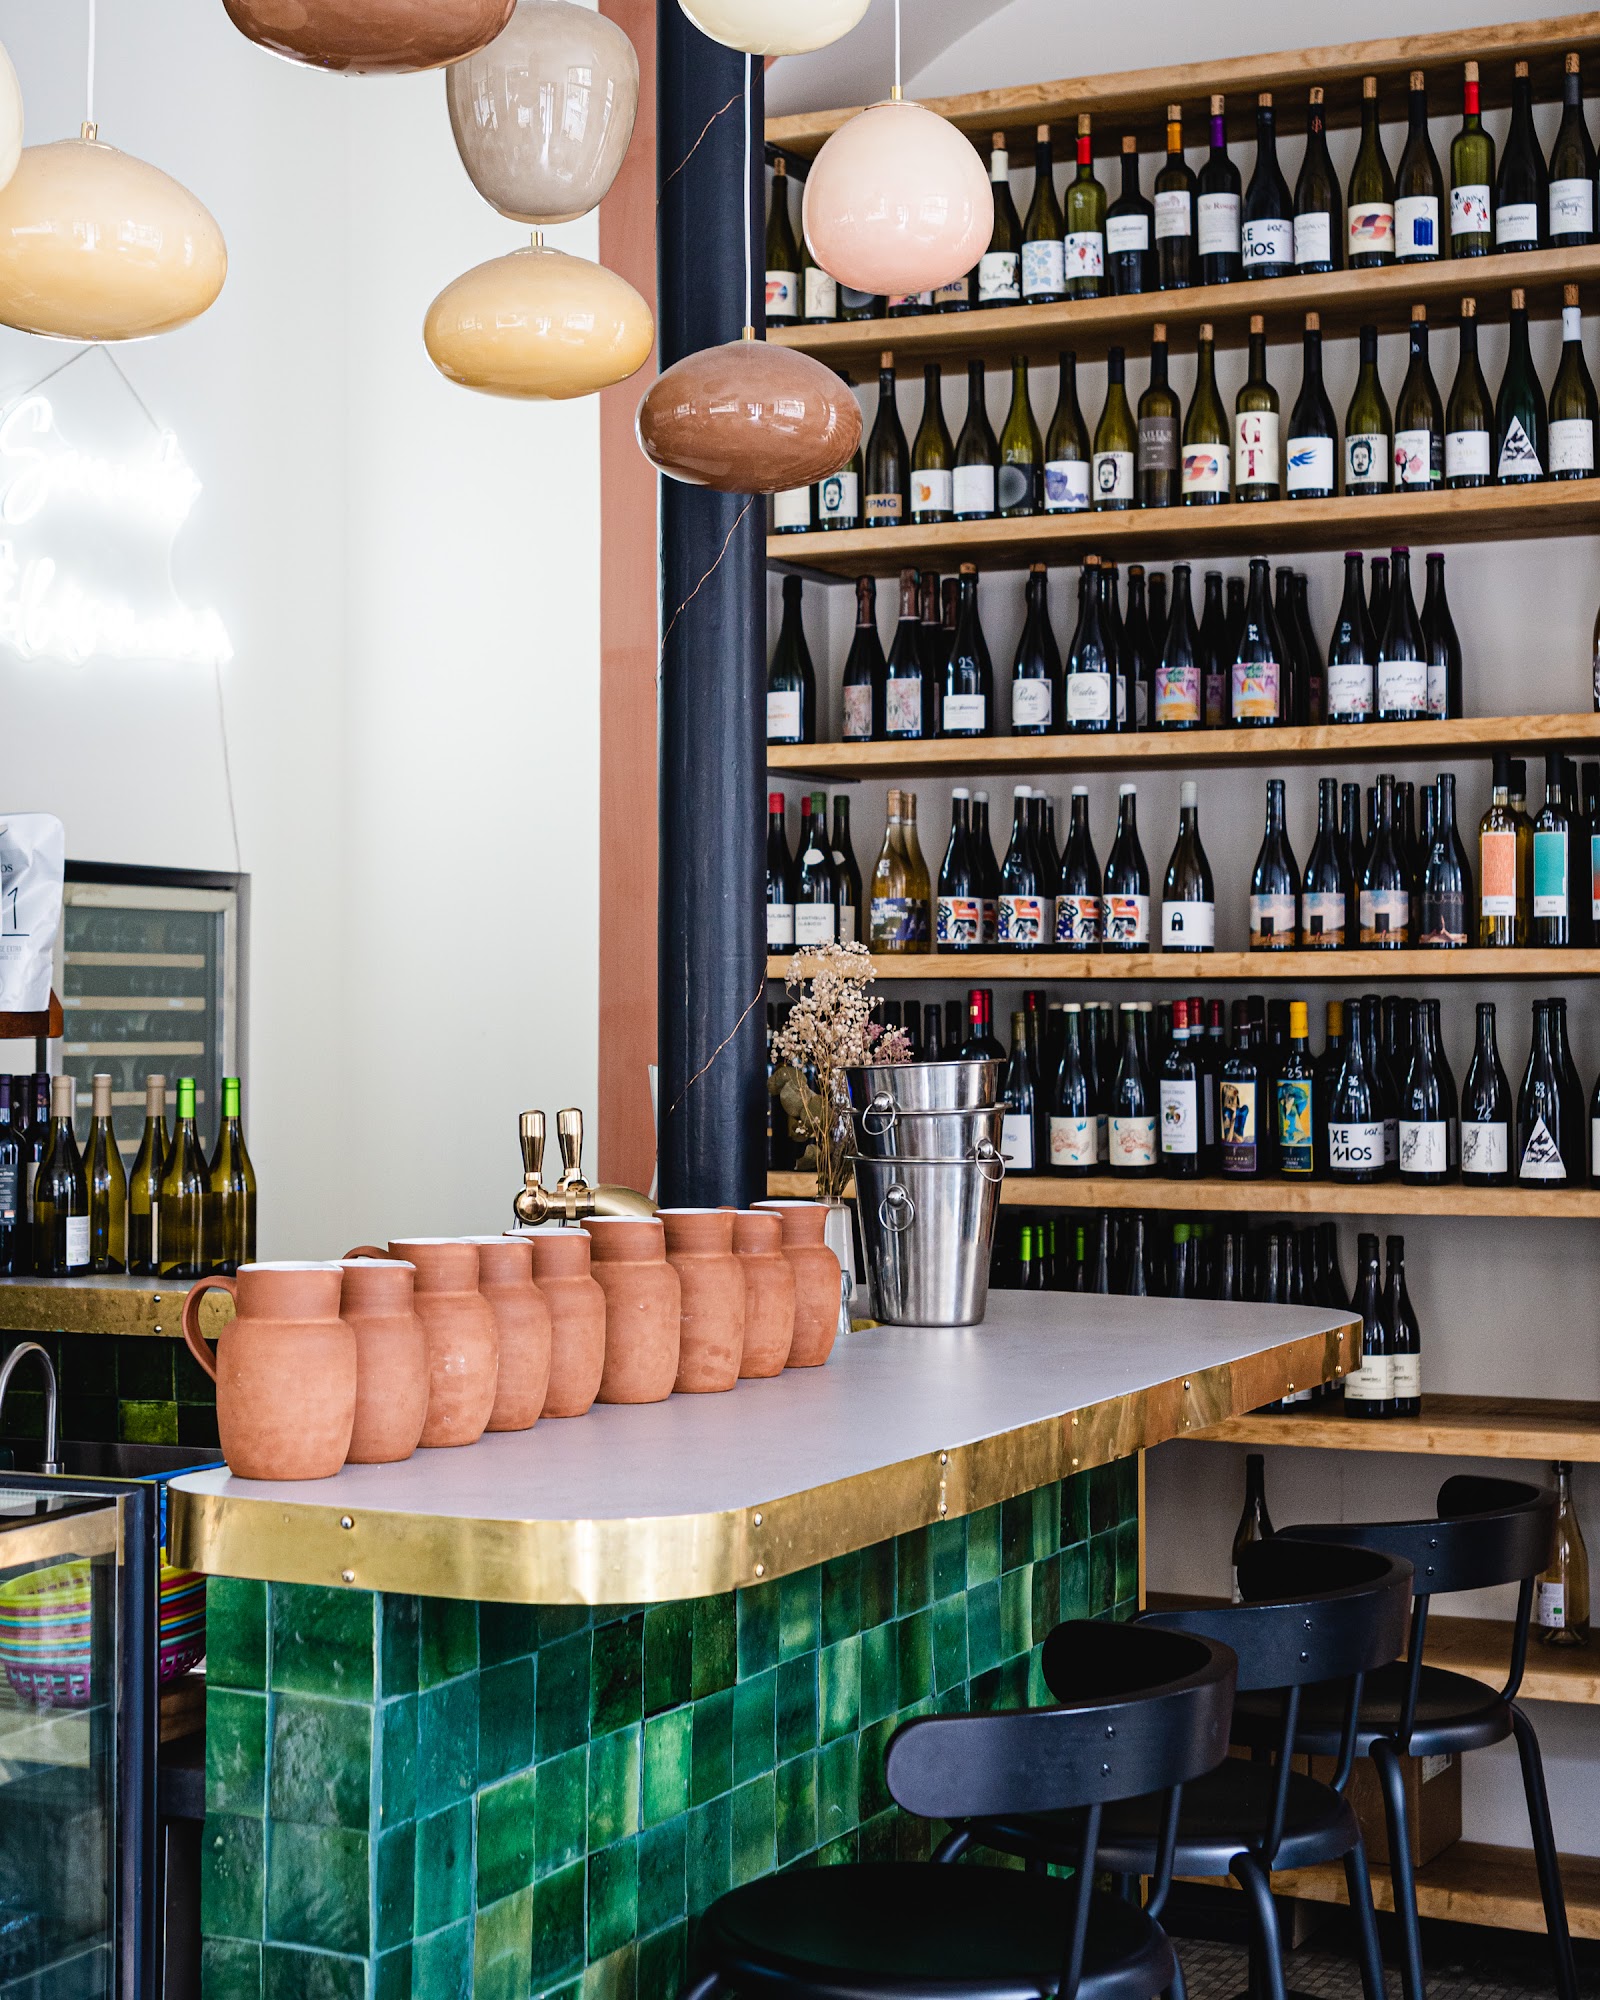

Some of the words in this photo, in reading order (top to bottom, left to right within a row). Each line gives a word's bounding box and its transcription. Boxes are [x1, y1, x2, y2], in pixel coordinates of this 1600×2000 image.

[7, 887, 18, 930] 1
[1287, 1066, 1302, 1078] 25
[1332, 1130, 1349, 1143] XE
